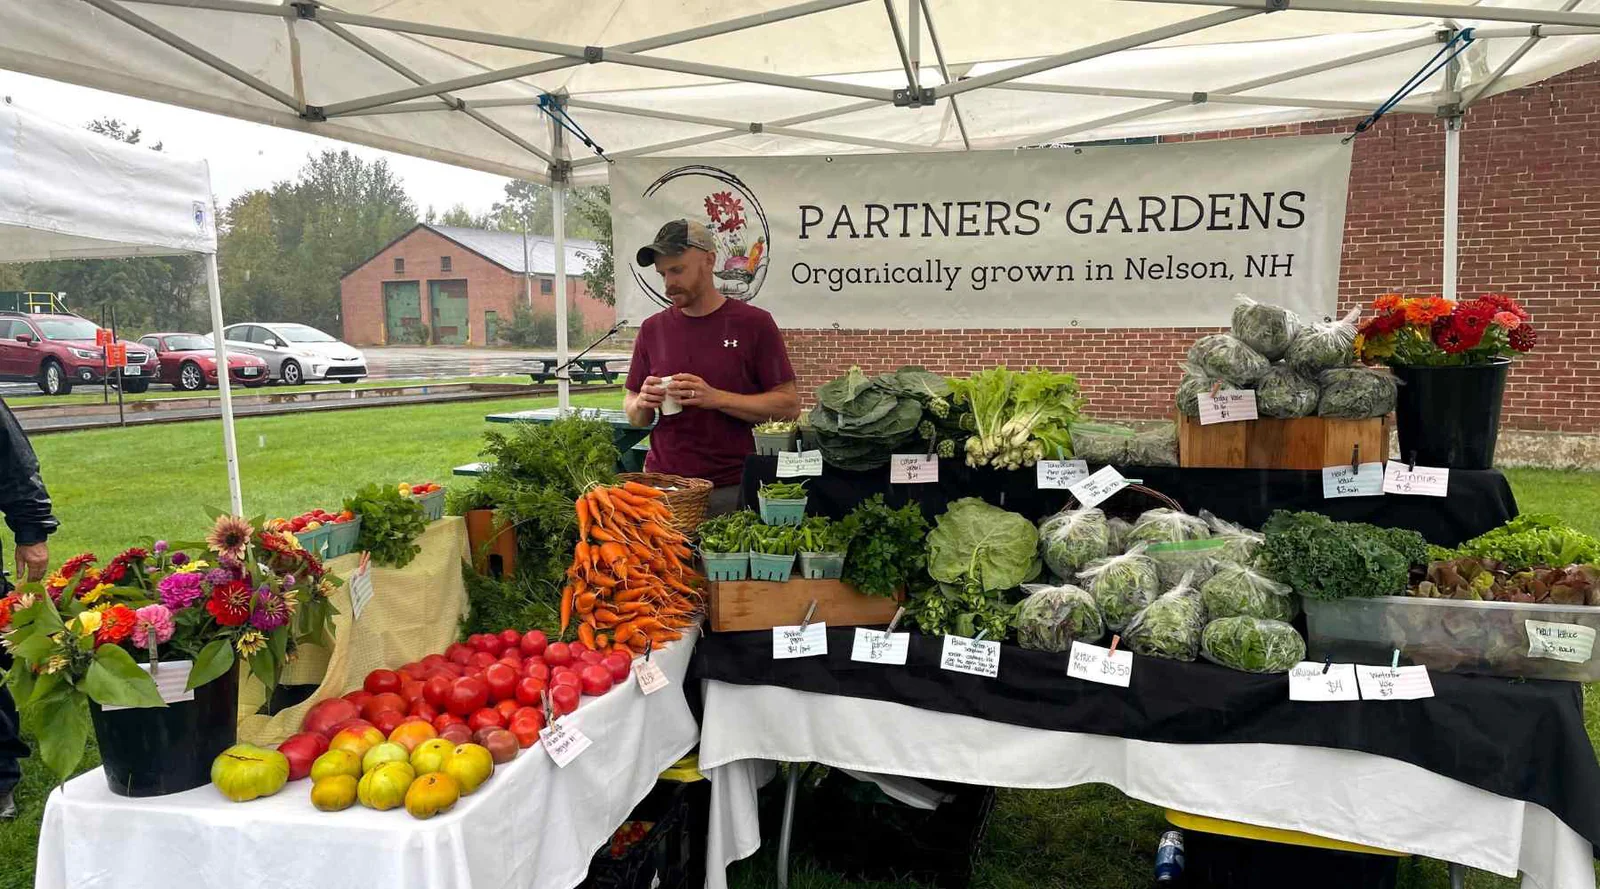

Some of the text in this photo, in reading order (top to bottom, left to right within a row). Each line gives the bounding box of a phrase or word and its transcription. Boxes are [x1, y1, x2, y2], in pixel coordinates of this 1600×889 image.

[799, 190, 1307, 240] PARTNERS' GARDENS
[792, 253, 1295, 292] Organically grown in Nelson, NH
[1393, 469, 1438, 484] Zinnias
